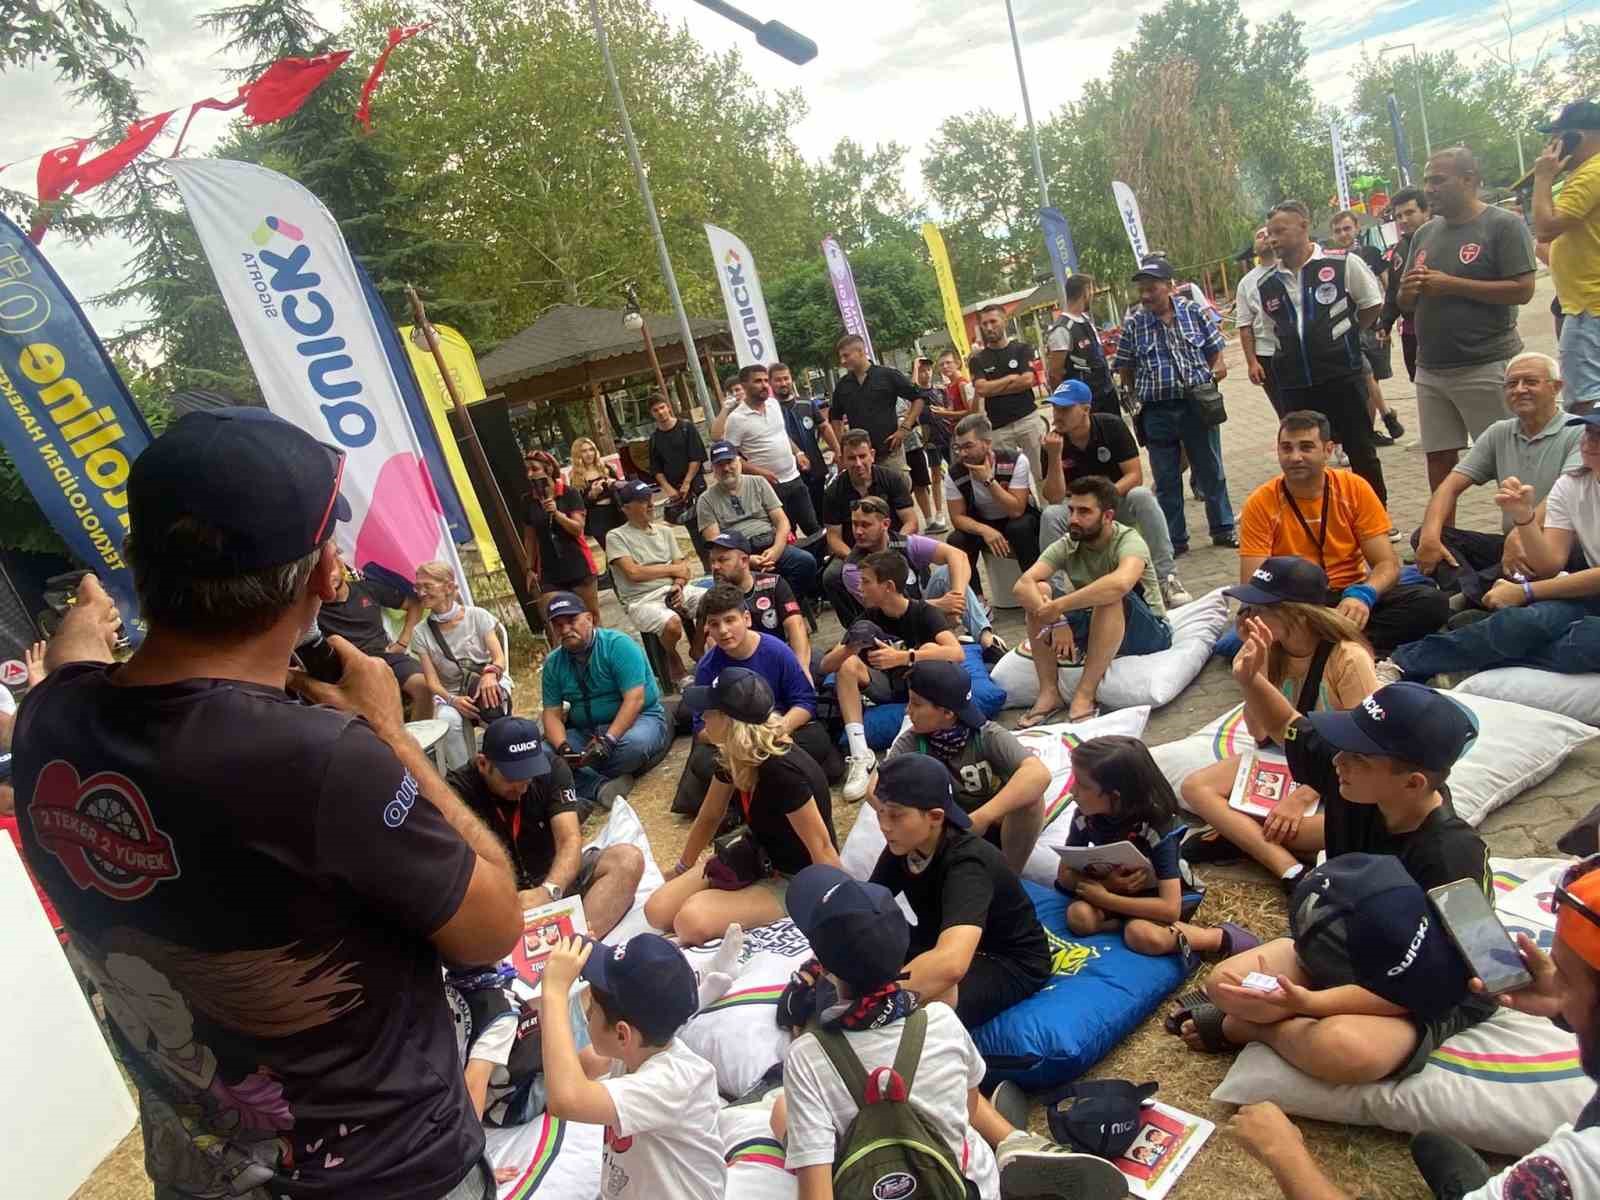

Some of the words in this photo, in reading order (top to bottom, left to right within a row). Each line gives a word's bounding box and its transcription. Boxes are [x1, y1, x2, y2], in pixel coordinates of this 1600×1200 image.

[52, 811, 97, 844] TEKER
[101, 837, 112, 851] 2
[1387, 922, 1428, 976] QUICK
